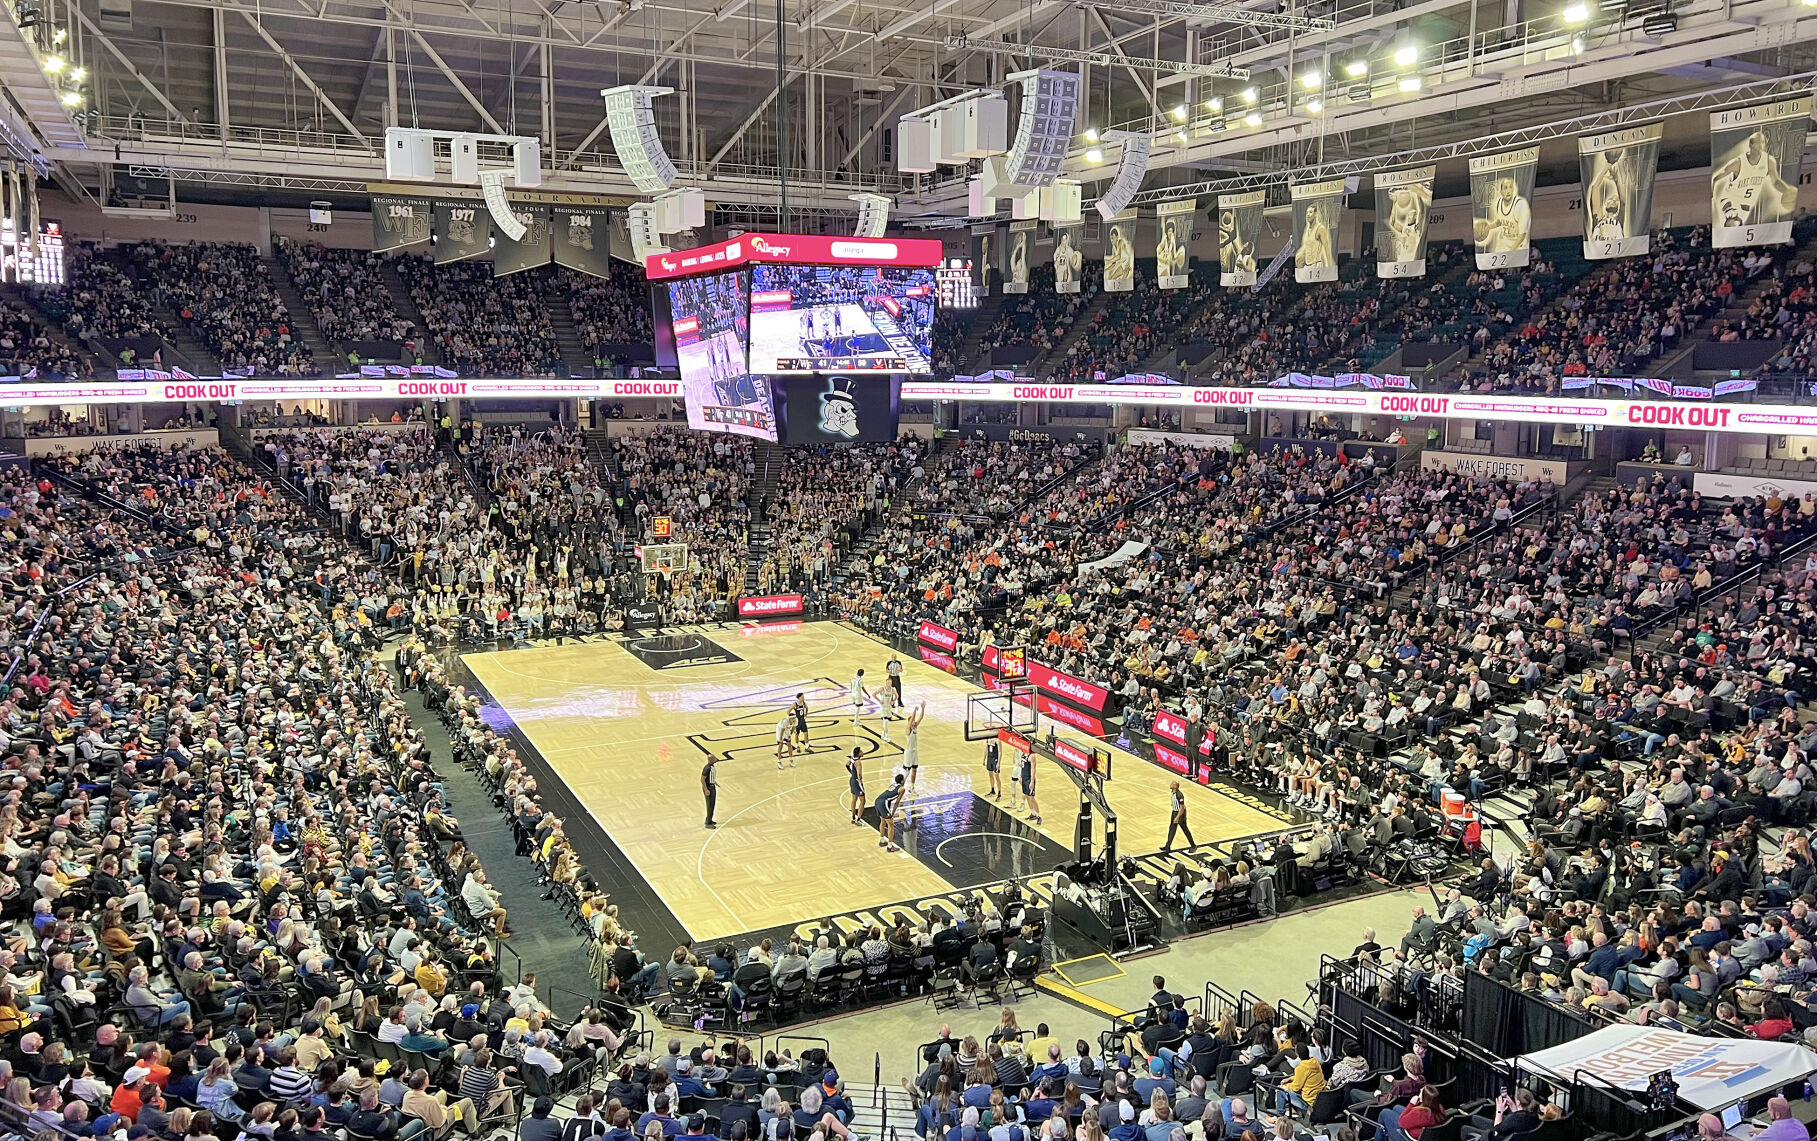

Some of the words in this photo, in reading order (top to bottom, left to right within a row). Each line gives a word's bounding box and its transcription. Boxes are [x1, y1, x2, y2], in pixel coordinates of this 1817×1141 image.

[1720, 101, 1800, 124] HOWARD
[1593, 129, 1646, 147] DUNCAN
[1473, 151, 1535, 169] CHILDRESS
[1382, 169, 1428, 183] ROGERS
[1744, 188, 1754, 199] 5
[374, 197, 406, 205] REGIONAL
[389, 205, 414, 218] 1961
[450, 208, 475, 221] 1977
[554, 207, 584, 215] REGIONAL
[175, 213, 197, 224] 239
[569, 214, 592, 227] 1984
[306, 223, 328, 232] 240
[1746, 229, 1754, 242] 5
[755, 242, 791, 257] Allegacy
[1604, 241, 1622, 256] 21
[1491, 254, 1507, 267] 22
[1309, 269, 1321, 280] 14
[1393, 264, 1408, 275] 54
[1113, 280, 1121, 290] 12
[1165, 276, 1175, 286] 15
[1232, 275, 1244, 285] 32
[164, 384, 208, 399] COOK
[209, 384, 236, 398] OUT
[398, 382, 438, 395] COOK
[440, 382, 467, 395] OUT
[614, 382, 652, 395] COOK
[653, 382, 679, 395] OUT
[1013, 387, 1048, 399] COOK
[1049, 387, 1074, 399] OUT
[1194, 390, 1228, 403] COOK
[1229, 391, 1254, 405] OUT
[1380, 396, 1419, 412] COOK
[1420, 397, 1449, 414] OUT
[1628, 405, 1685, 424] COOK
[1688, 407, 1731, 427] OUT
[1740, 413, 1799, 424] CHARGRILLED
[1008, 429, 1050, 442] #GoDeacs
[92, 439, 121, 451] WAKE
[1431, 457, 1441, 468] WF
[1456, 458, 1483, 473] WAKE
[1486, 461, 1525, 477] FOREST
[1542, 467, 1553, 476] WF
[655, 524, 667, 535] 30
[526, 632, 630, 648] WAKE
[635, 619, 760, 639] FOREST
[661, 655, 727, 669] ACC
[1207, 782, 1296, 820] #GoDeacs
